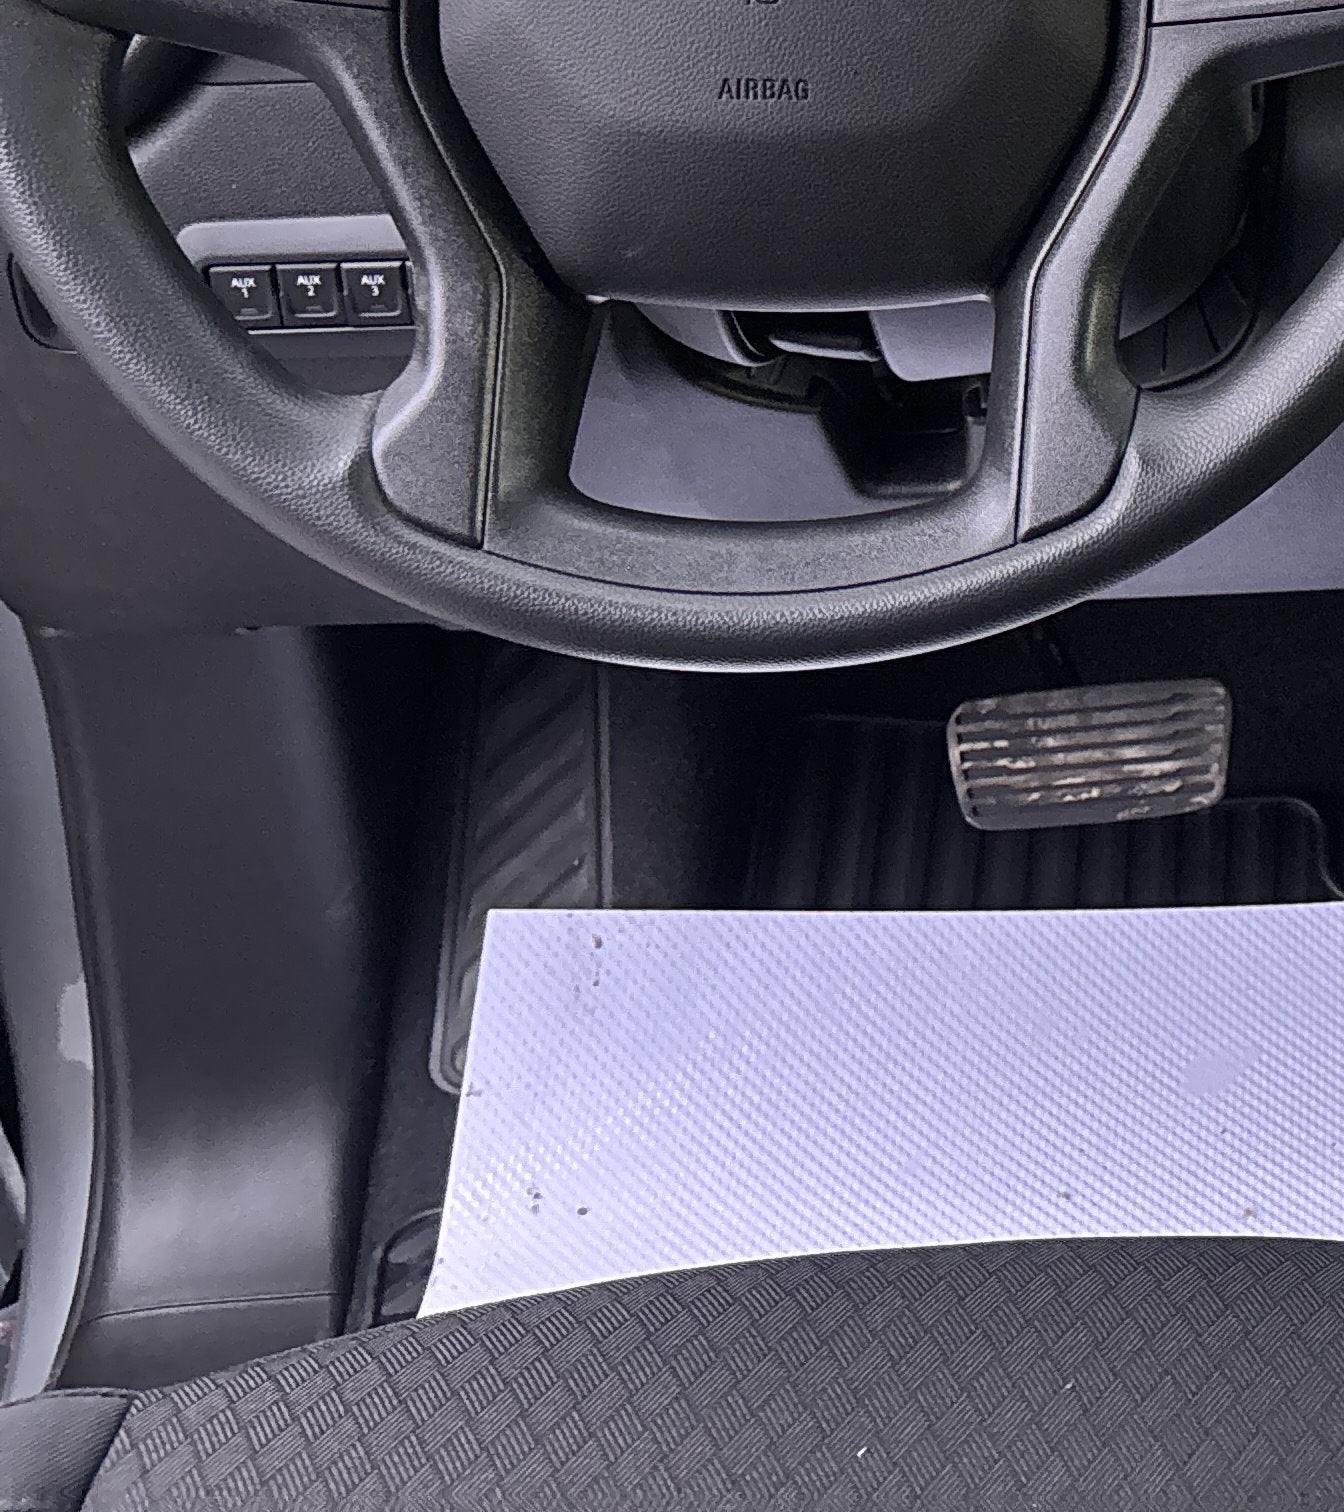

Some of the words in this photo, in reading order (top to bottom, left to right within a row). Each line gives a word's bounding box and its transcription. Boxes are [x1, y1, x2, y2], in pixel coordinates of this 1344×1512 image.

[718, 78, 809, 100] AIRBAG
[231, 277, 256, 288] AUX
[296, 274, 322, 286] AUX
[361, 274, 386, 286] AUX
[241, 288, 249, 298] 1
[307, 286, 315, 297] 2
[371, 286, 380, 296] 3
